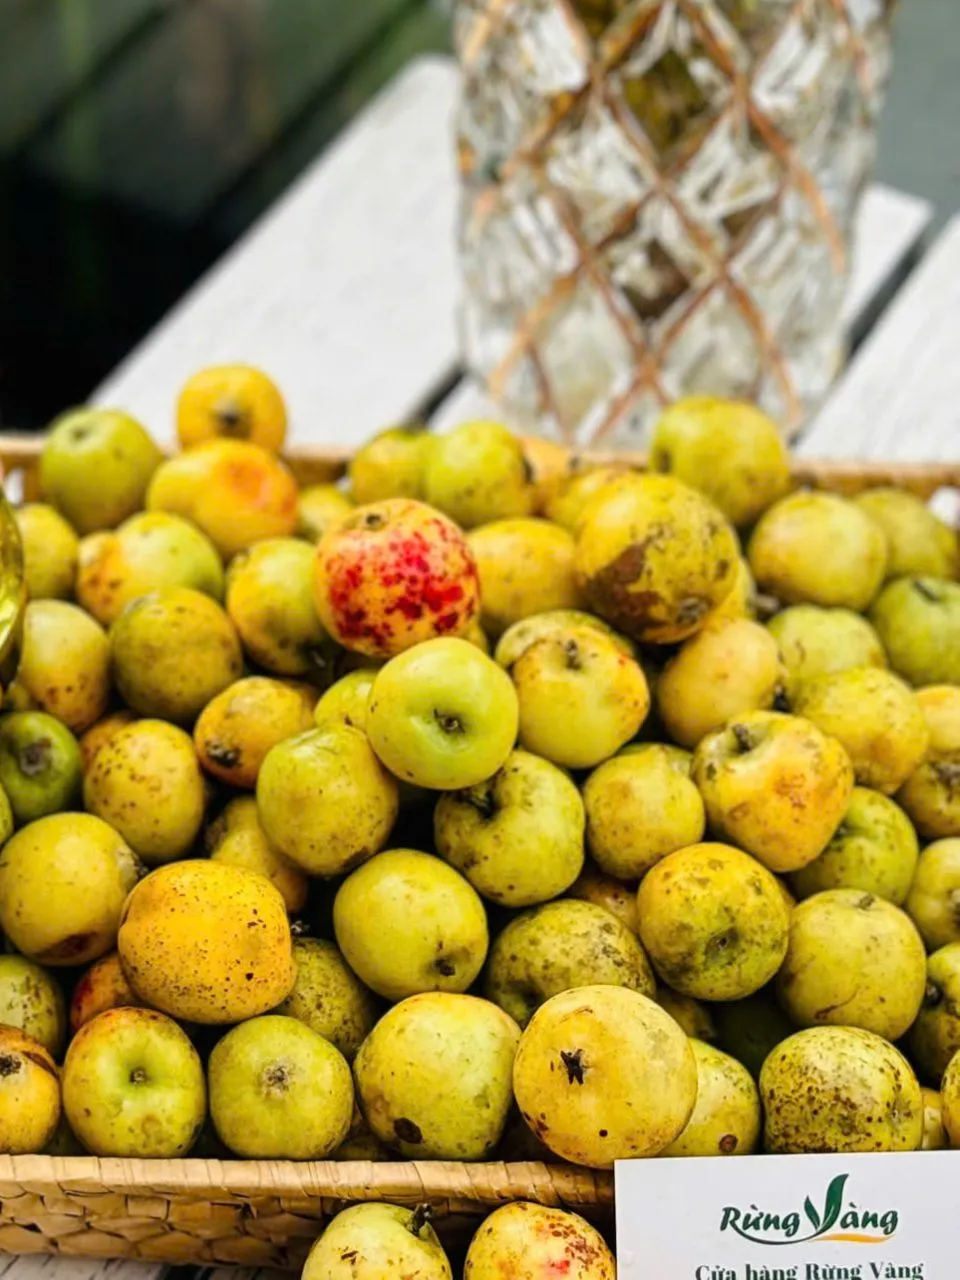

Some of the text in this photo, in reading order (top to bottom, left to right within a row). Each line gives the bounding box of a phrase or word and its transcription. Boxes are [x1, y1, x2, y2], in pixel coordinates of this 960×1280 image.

[695, 1262, 924, 1280] Cửa hàng Rừng Vàng
